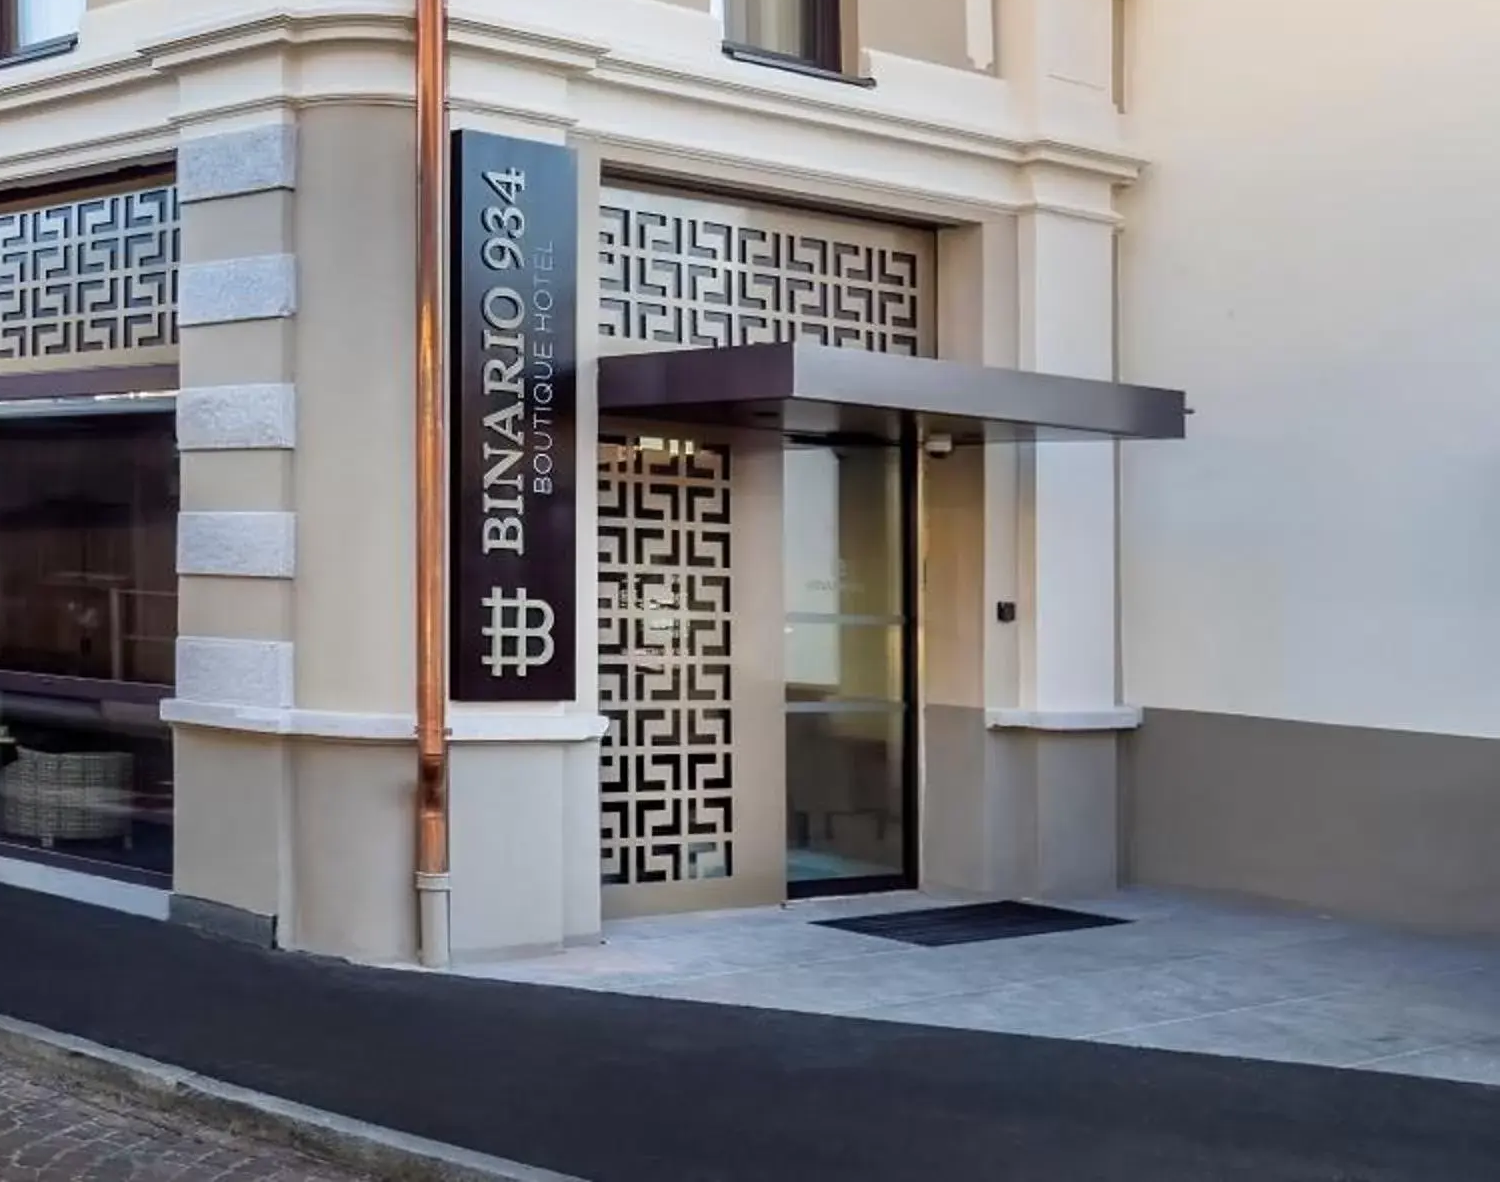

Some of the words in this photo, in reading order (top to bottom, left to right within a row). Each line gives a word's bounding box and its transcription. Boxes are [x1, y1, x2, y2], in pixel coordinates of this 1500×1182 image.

[482, 167, 526, 270] 934
[533, 240, 555, 333] HOTEL
[481, 286, 525, 556] BINARIO
[533, 341, 554, 495] BOUTIQUE
